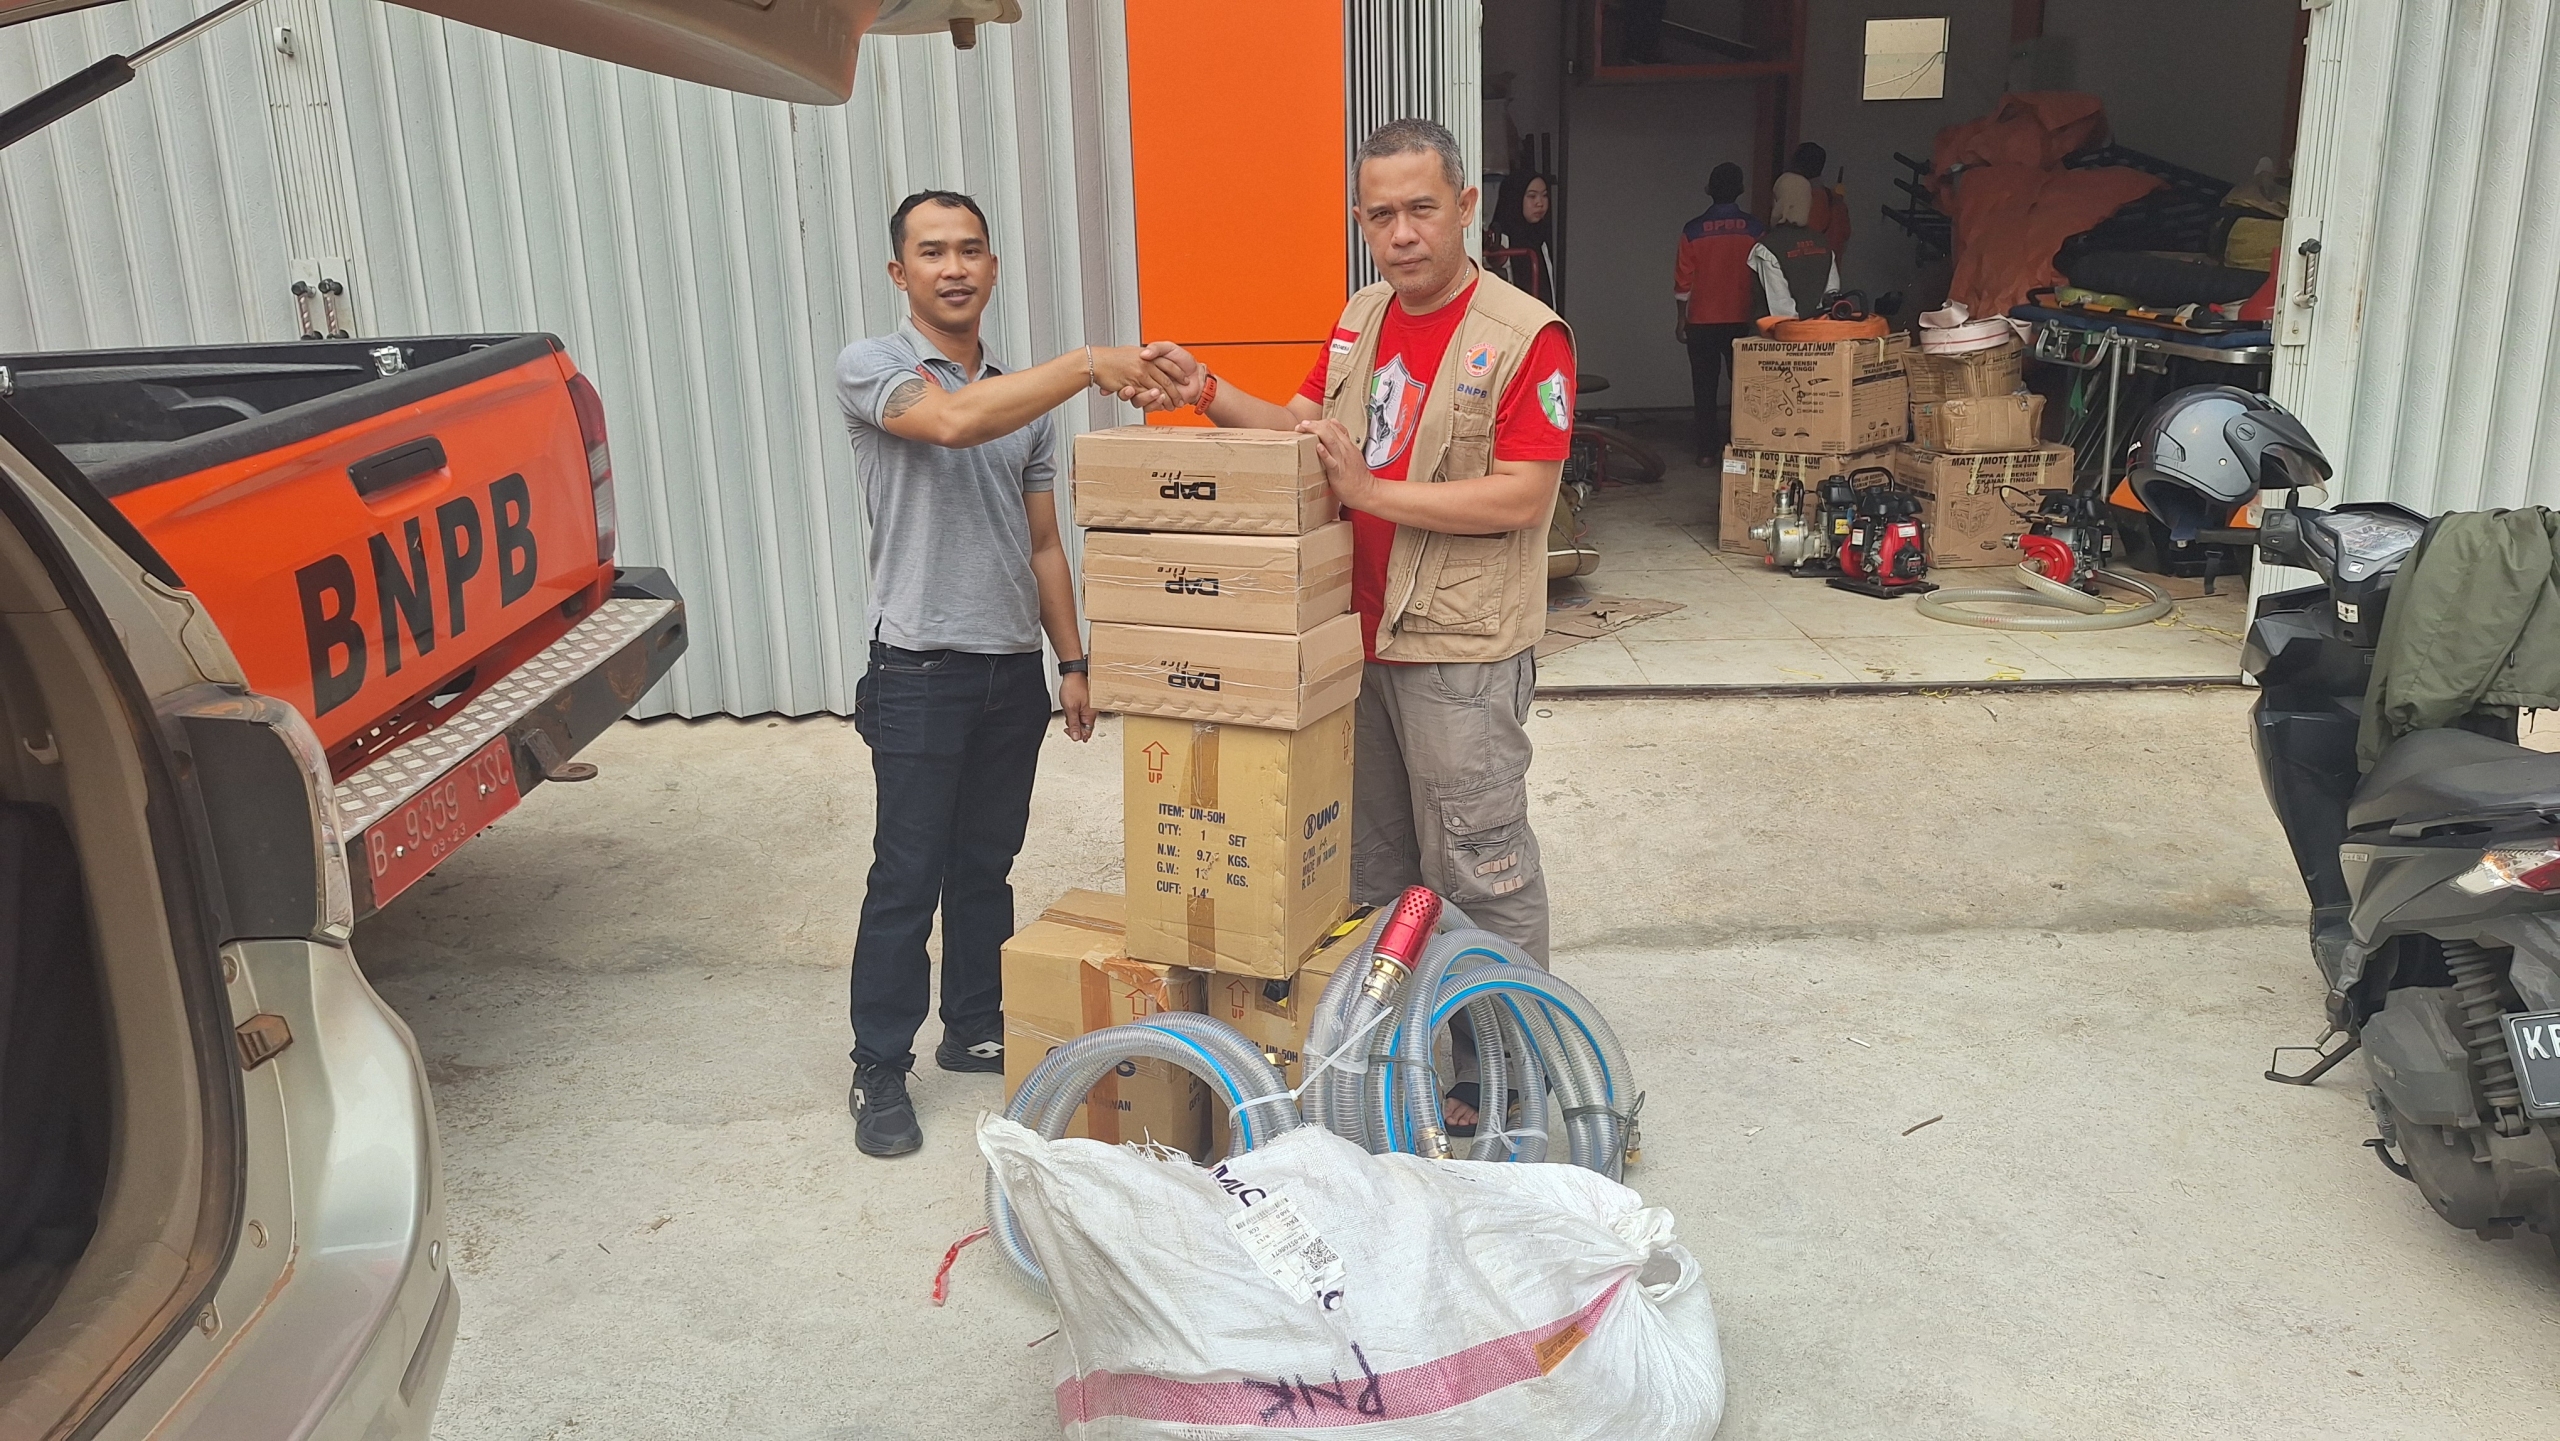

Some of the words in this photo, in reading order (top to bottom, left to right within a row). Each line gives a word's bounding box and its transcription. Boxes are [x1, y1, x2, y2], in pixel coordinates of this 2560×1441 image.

[1457, 383, 1488, 399] BNPB
[1159, 481, 1216, 501] DAP
[294, 472, 537, 718] BNPB
[1165, 576, 1219, 597] DAP
[1168, 673, 1221, 692] DAP
[1148, 771, 1163, 784] UP
[371, 829, 388, 878] B
[405, 780, 459, 850] 9359
[471, 743, 510, 801] TSC
[1158, 803, 1185, 818] ITEM:
[1189, 807, 1226, 825] UN-50H
[1316, 800, 1340, 831] UNO
[1157, 822, 1182, 837] Q'TY:
[1200, 829, 1206, 841] 1
[1228, 833, 1248, 848] SET
[1157, 842, 1181, 858] N.W.:
[1227, 854, 1250, 869] KGS.
[1156, 860, 1180, 876] G.W.:
[1226, 872, 1249, 888] KGS.
[1302, 859, 1316, 877] MADE
[1156, 879, 1182, 895] CUFT:
[1232, 1007, 1245, 1020] UP
[1242, 1340, 1386, 1423] PNK
